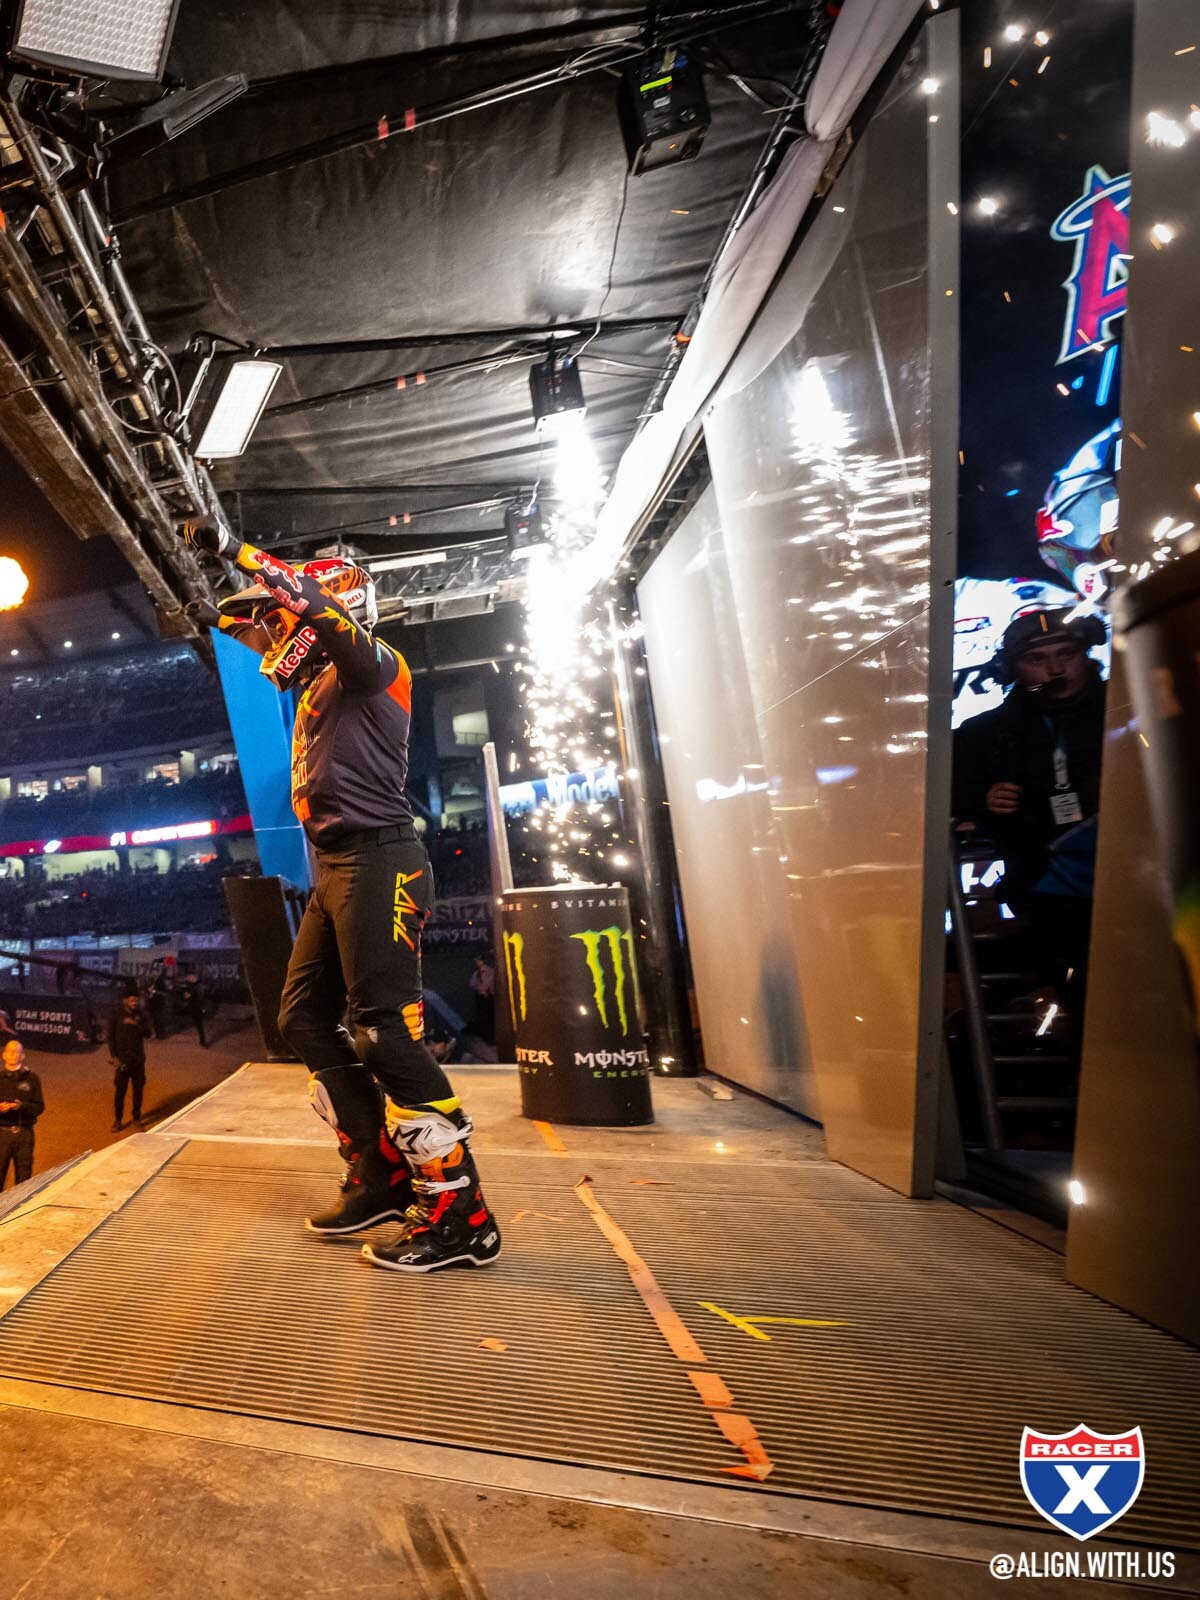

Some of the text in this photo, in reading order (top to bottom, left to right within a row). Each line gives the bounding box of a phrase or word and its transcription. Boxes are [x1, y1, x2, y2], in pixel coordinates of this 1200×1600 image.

[346, 592, 363, 606] BELL
[15, 1009, 73, 1023] UTAH SPORTS
[15, 1021, 72, 1035] COMMISSION
[574, 1050, 649, 1069] MONST
